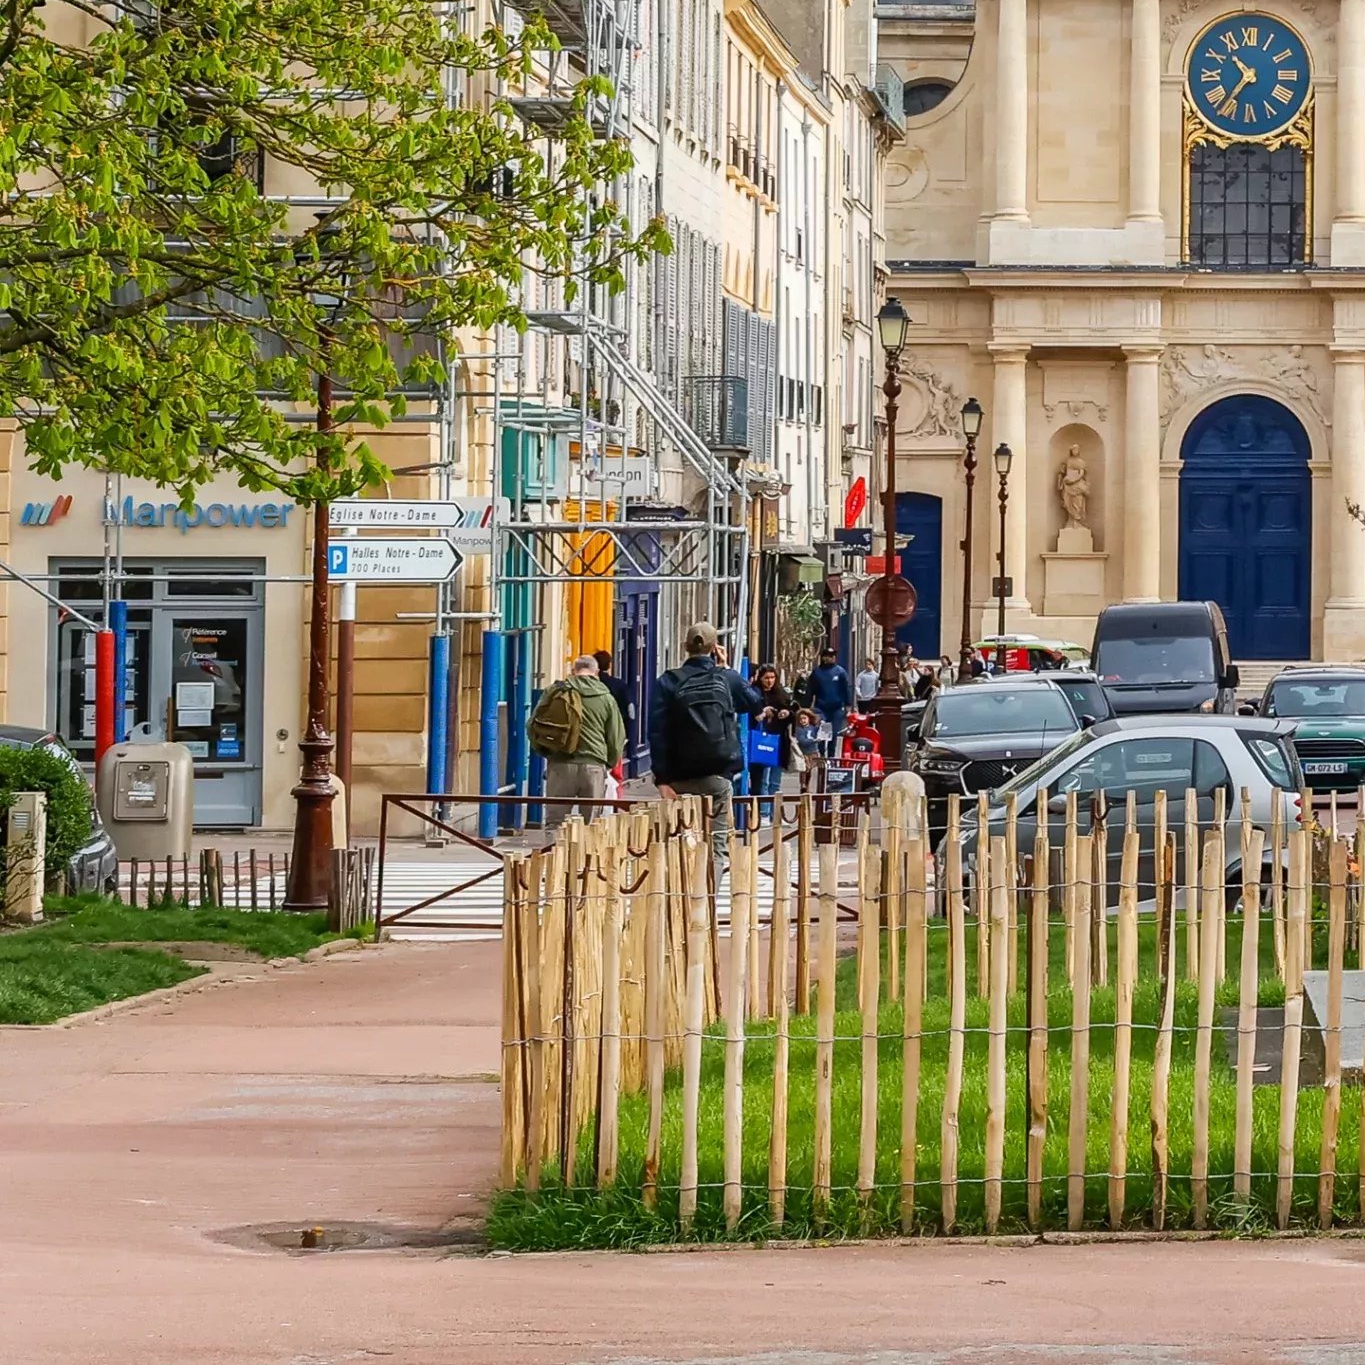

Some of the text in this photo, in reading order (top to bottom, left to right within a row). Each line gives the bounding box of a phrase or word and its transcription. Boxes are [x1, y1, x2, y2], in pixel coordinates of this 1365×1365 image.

[103, 495, 294, 535] Manpower
[453, 536, 502, 547] Manpowr
[352, 547, 379, 558] Halles
[332, 550, 344, 570] P
[351, 563, 401, 573] 700 Places
